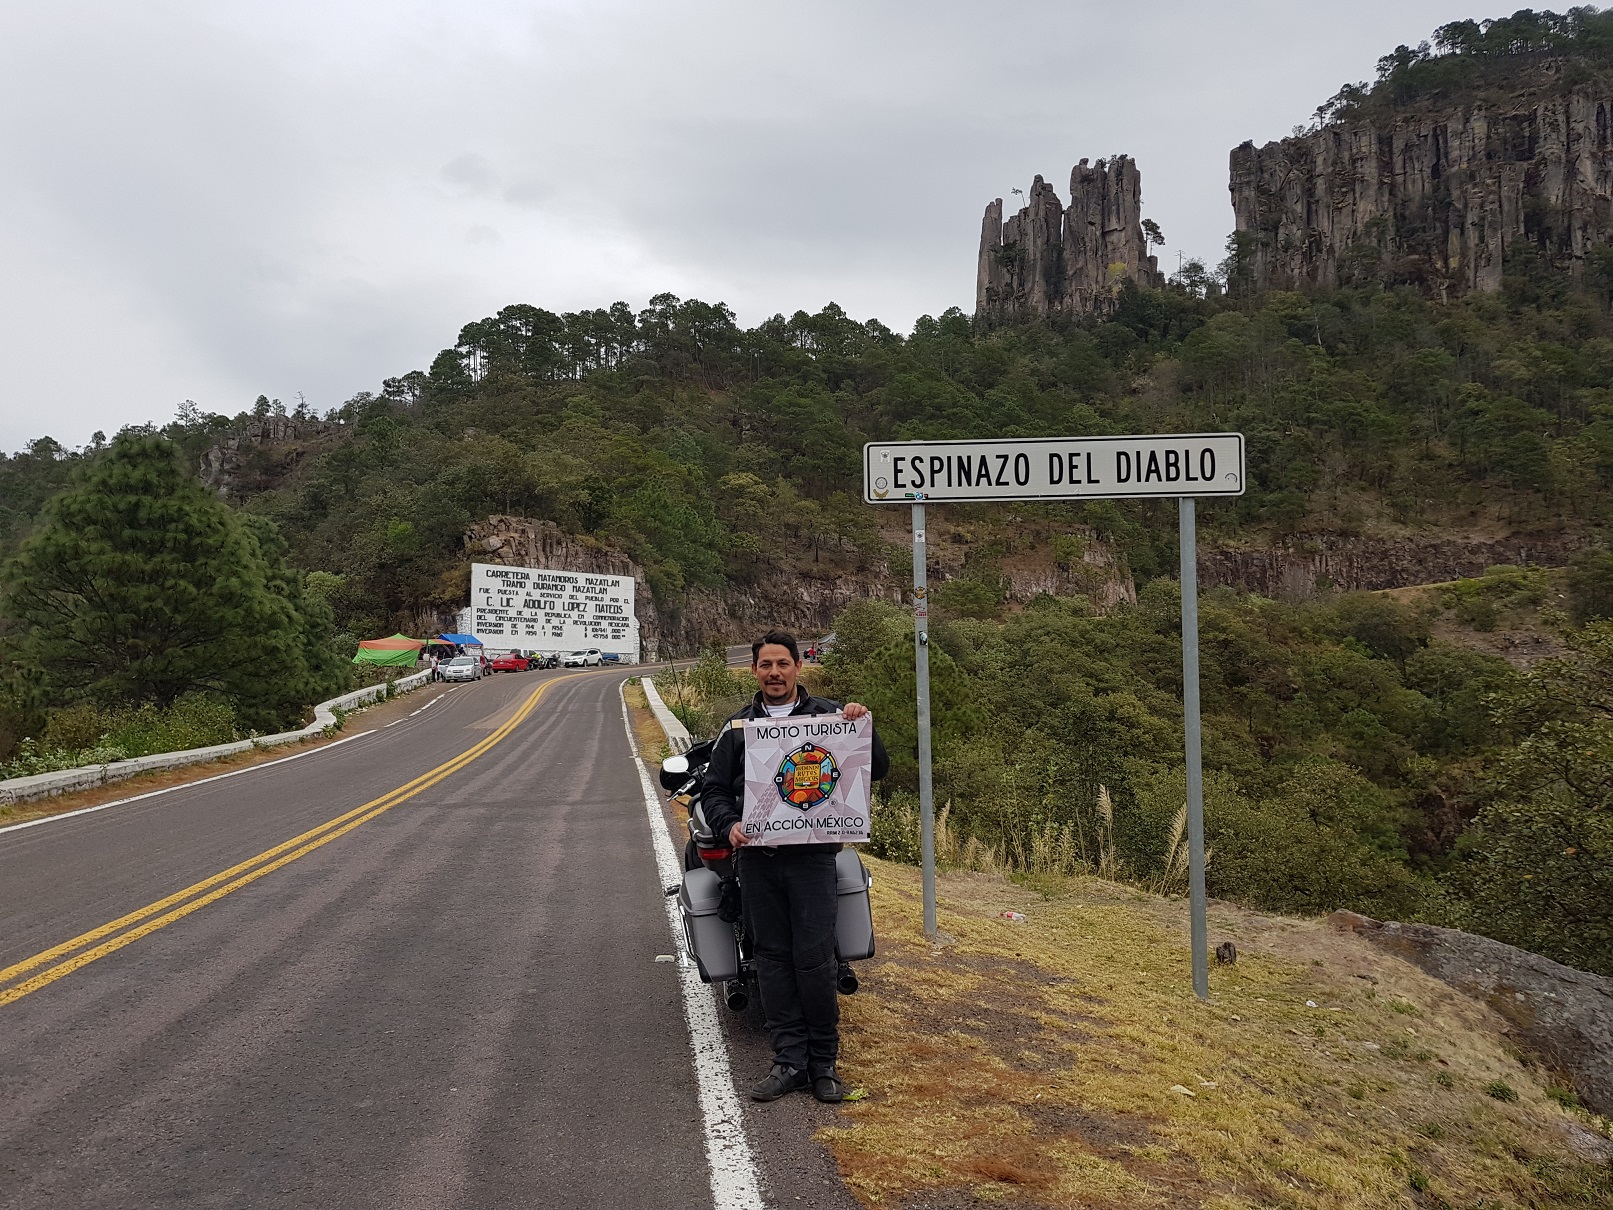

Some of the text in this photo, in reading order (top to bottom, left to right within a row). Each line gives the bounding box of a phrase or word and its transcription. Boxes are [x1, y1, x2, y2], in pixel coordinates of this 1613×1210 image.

[893, 448, 1215, 488] ESPINAZO DEL DIABLO
[486, 570, 620, 587] CARRETERA MATAMOROS MAZATLAN
[502, 580, 607, 595] TRAMO DURANGO MAZATLAN
[487, 597, 623, 614] C. LIC. ADOLFO LOPEZ MATEOS
[757, 723, 856, 740] MOTO TURISTA
[746, 815, 863, 834] EN ACCIÓN MÉXICO
